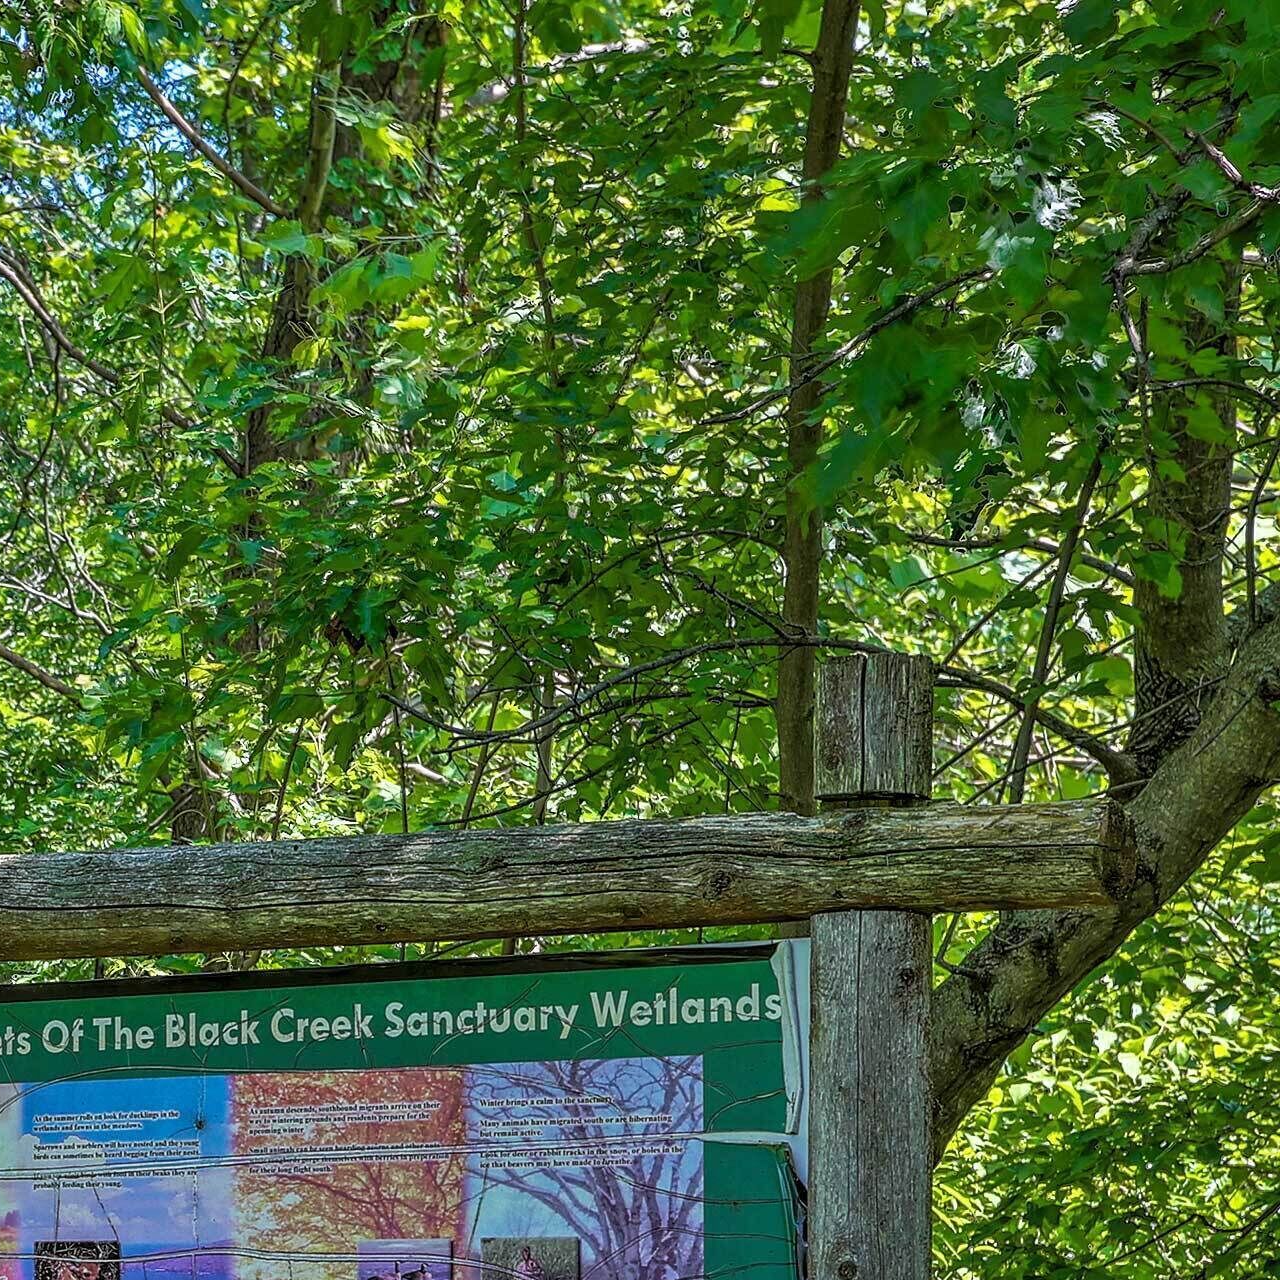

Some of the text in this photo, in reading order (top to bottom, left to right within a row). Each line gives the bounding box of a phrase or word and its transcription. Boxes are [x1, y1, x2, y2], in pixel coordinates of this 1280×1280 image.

[41, 1018, 86, 1053] Of
[92, 1015, 155, 1051] The
[165, 1009, 261, 1049] Black
[270, 1003, 375, 1043] Creek
[383, 1002, 579, 1040] Sanctuary
[589, 983, 783, 1028] Wetlands
[249, 1107, 258, 1115] As
[285, 1105, 317, 1114] descends,
[318, 1103, 358, 1113] southbound
[358, 1103, 389, 1112] migrants
[390, 1102, 412, 1110] arrive
[423, 1101, 440, 1109] their
[479, 1098, 505, 1107] Winter
[506, 1097, 529, 1107] brings
[535, 1097, 553, 1105] calm
[33, 1115, 42, 1123] As
[80, 1113, 94, 1121] rolls
[103, 1112, 117, 1120] look
[118, 1112, 128, 1120] for
[128, 1111, 159, 1120] ducklings
[167, 1110, 178, 1118] the
[271, 1116, 304, 1125] wintering
[304, 1115, 332, 1124] grounds
[346, 1114, 378, 1122] residents
[378, 1113, 406, 1122] prepare
[406, 1112, 418, 1120] for
[418, 1111, 430, 1119] the
[479, 1120, 501, 1129] Many
[501, 1118, 530, 1127] animals
[530, 1118, 548, 1126] have
[549, 1117, 582, 1127] migrated
[583, 1116, 604, 1124] south
[628, 1114, 673, 1124] hibernating
[33, 1123, 74, 1132] wetlands and
[249, 1126, 305, 1136] upcoming winter
[479, 1128, 543, 1138] but remain active.
[479, 1150, 499, 1159] Look
[499, 1150, 510, 1158] for
[511, 1149, 529, 1158] deer
[539, 1148, 562, 1157] rabbit
[562, 1148, 586, 1156] tracks
[595, 1147, 608, 1155] the
[609, 1148, 631, 1156] snow,
[641, 1146, 661, 1154] holes
[661, 1145, 670, 1154] in
[670, 1145, 683, 1153] the
[479, 1158, 633, 1169] ice that beavers may have made to breathe.
